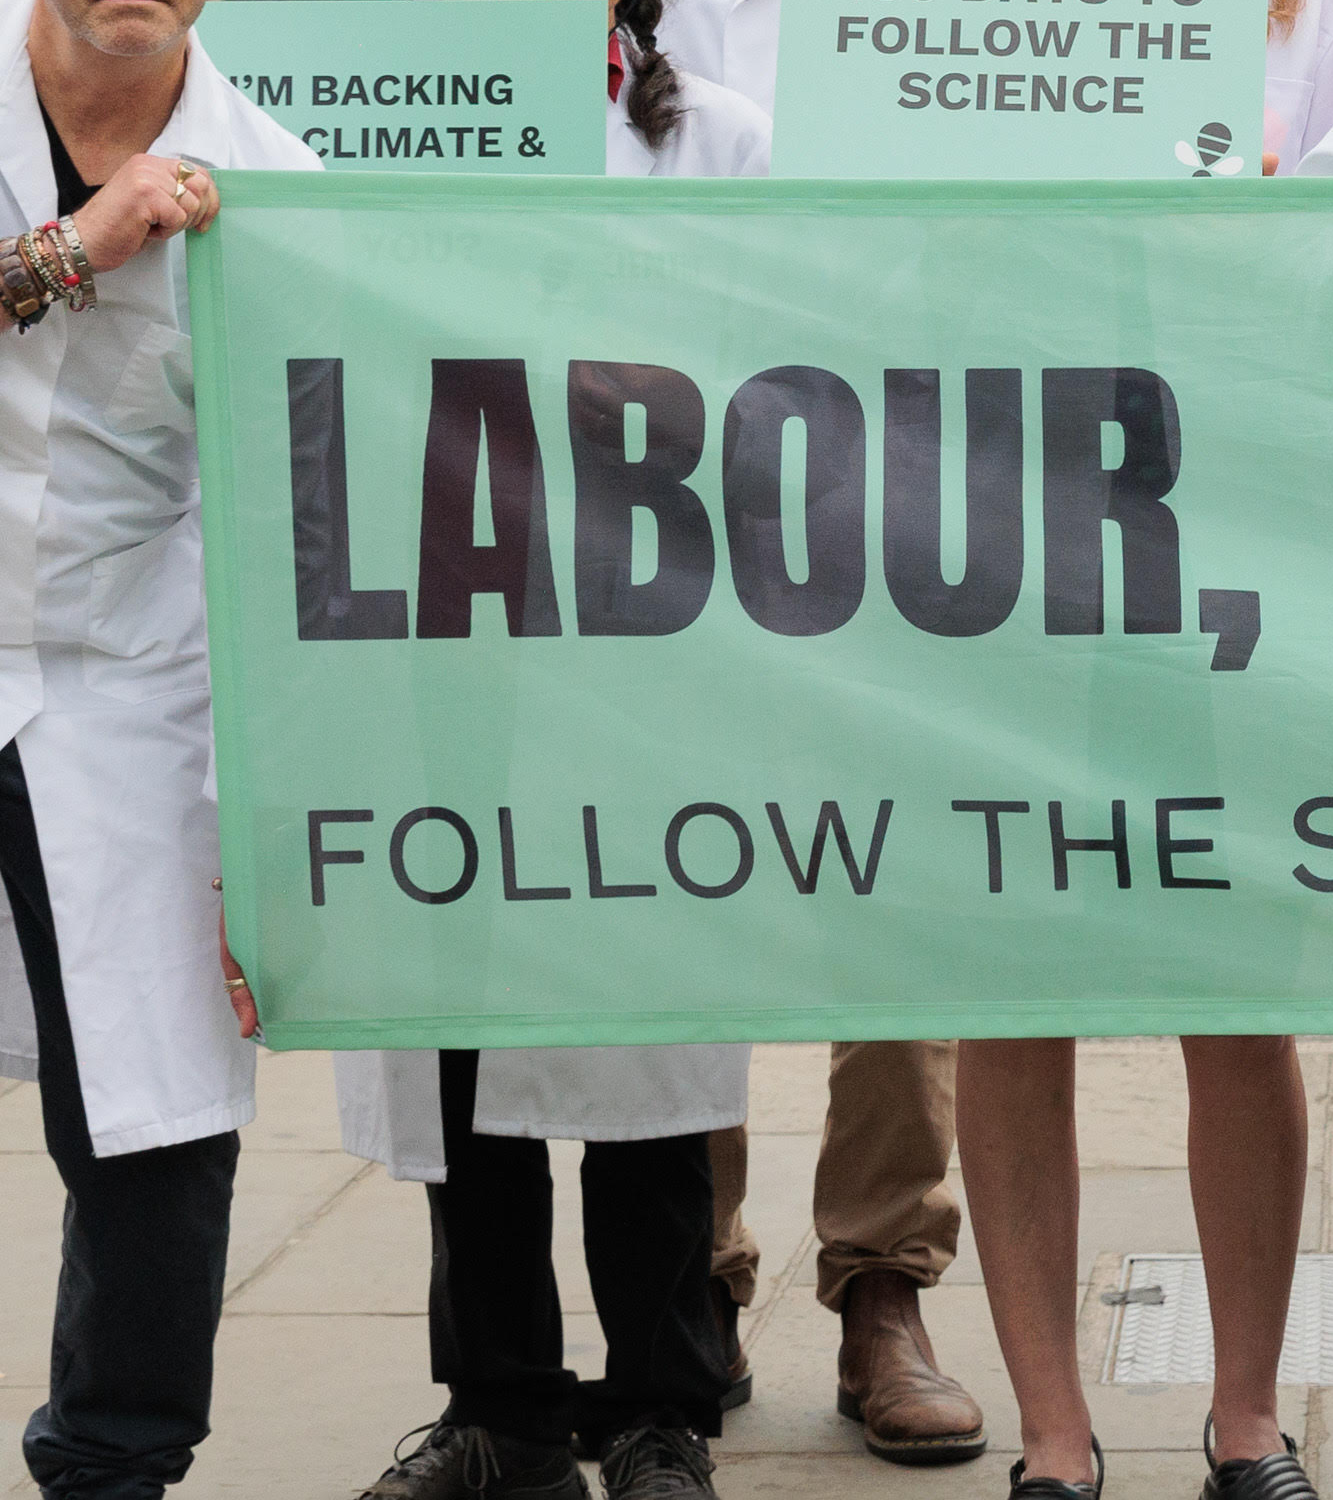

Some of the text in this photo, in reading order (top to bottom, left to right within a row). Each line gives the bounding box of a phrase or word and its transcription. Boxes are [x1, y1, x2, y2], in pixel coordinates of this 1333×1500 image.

[837, 16, 1211, 61] FOLLOW THE
[312, 74, 513, 106] BACKING
[897, 71, 1144, 114] SCIENCE
[302, 125, 546, 158] CLIMATE &
[285, 357, 1261, 672] LABOUR,
[306, 799, 895, 908] FOLLOW
[950, 799, 1233, 894] THE
